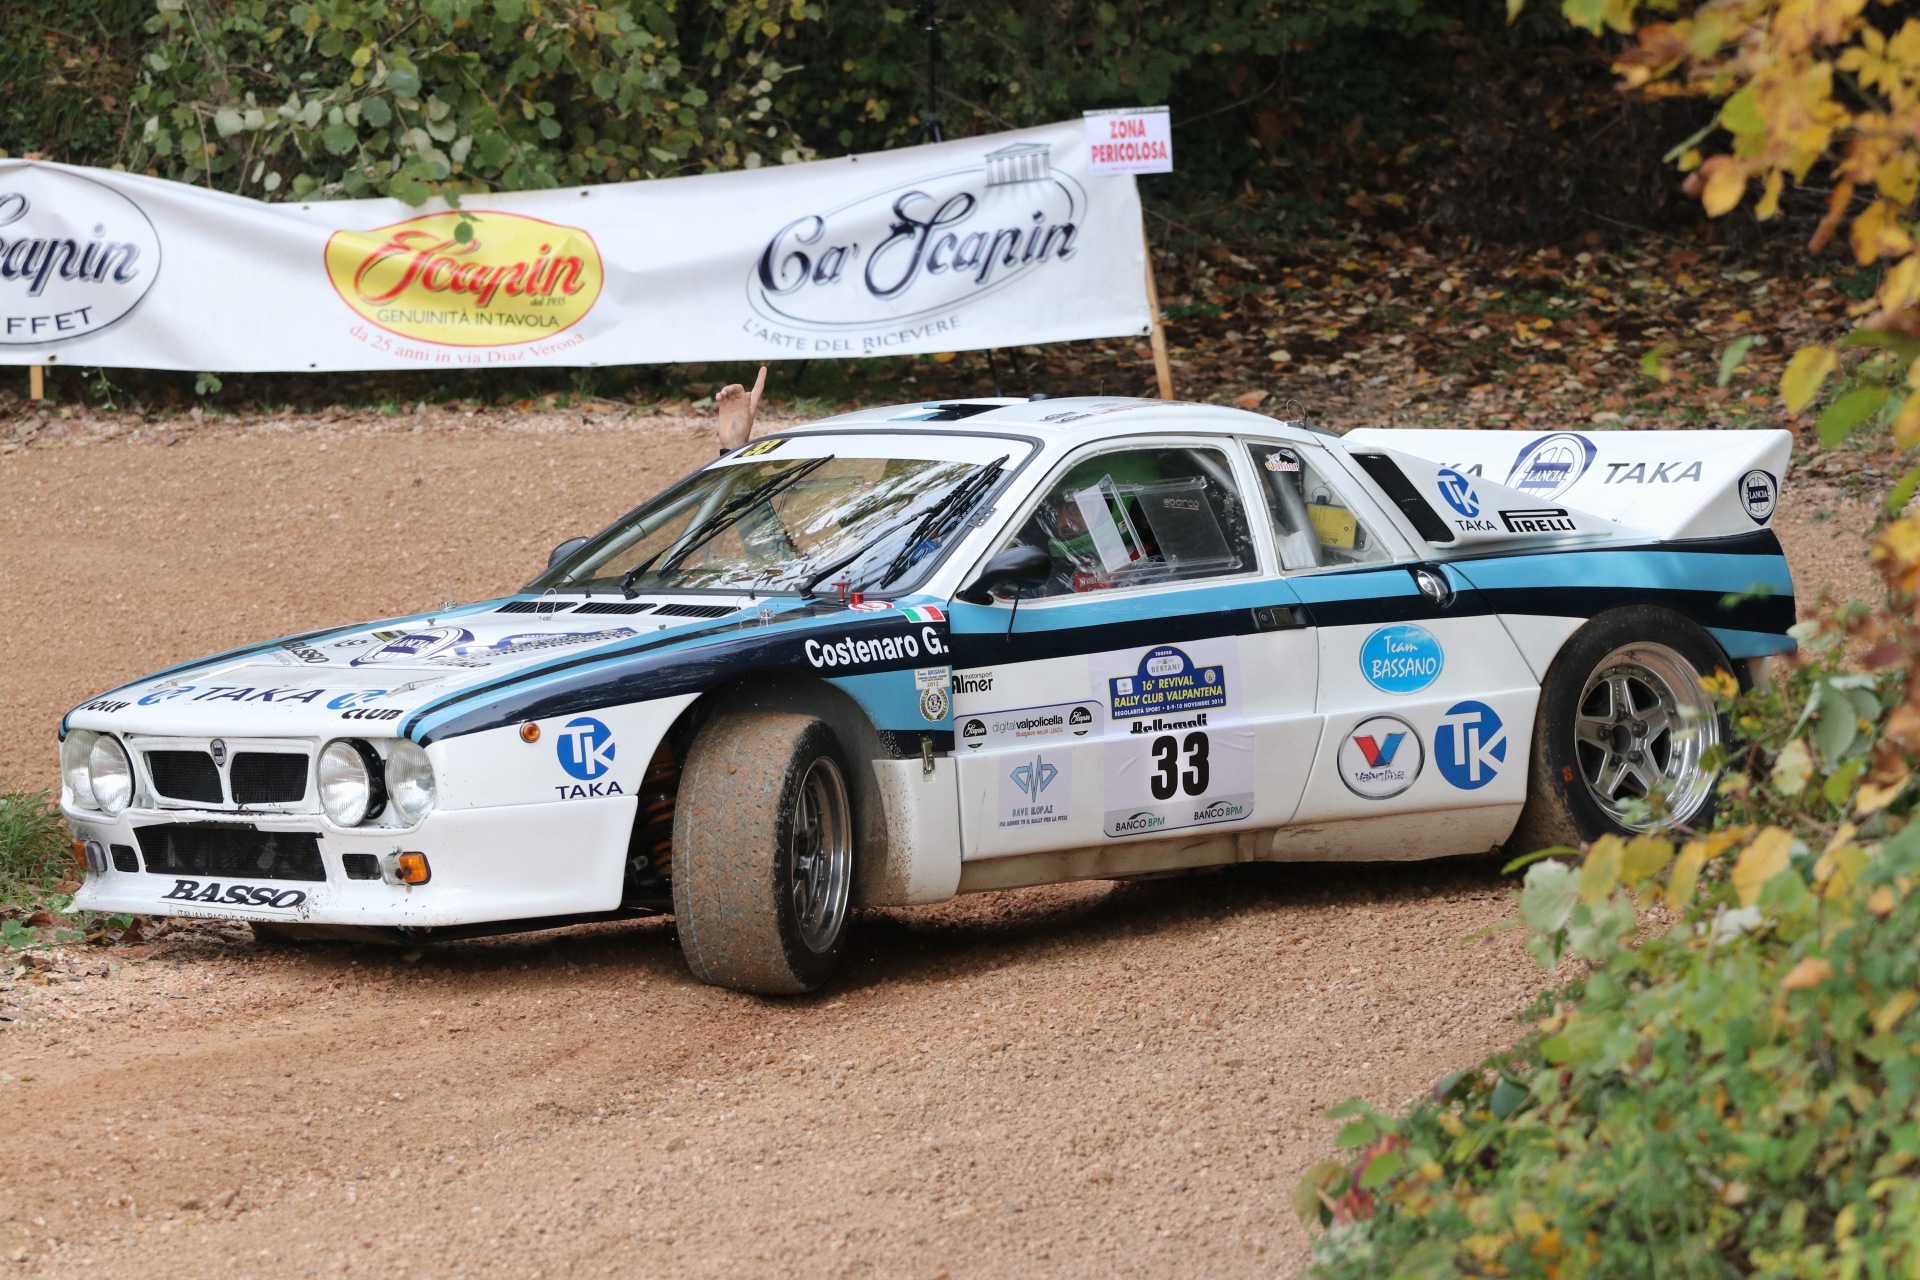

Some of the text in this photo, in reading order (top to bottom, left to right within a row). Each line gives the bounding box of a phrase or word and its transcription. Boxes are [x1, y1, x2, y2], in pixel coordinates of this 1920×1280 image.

[1110, 119, 1146, 139] ZONA
[1091, 141, 1168, 164] PERICOLOSA
[0, 192, 141, 297] apin
[864, 190, 1078, 301] Scapin
[354, 230, 585, 307] Scapin
[547, 296, 567, 307] 1935
[0, 306, 92, 334] FFET
[377, 307, 560, 328] GENUINITÀ IN TAVOLA
[743, 314, 961, 352] L'ARTE DEL RICEVERE
[349, 324, 586, 364] da 25 anni in via Diaz Verona
[1525, 469, 1563, 482] LANCIA
[1603, 461, 1703, 484] TAKA
[1455, 520, 1498, 531] TAKA
[1498, 508, 1577, 533] PIRELLI
[805, 626, 949, 668] Costenaro G.
[1384, 636, 1418, 653] Team
[964, 672, 993, 680] motorsport
[1151, 663, 1180, 673] BERTANI
[1372, 657, 1437, 679] BASSANO
[1159, 675, 1194, 689] REVIVAL
[192, 687, 327, 704] TAKA
[1114, 686, 1223, 708] RALLY CLUB VALPANTENA
[341, 708, 404, 720] CLUB
[1114, 707, 1144, 717] REGOLARITÀ
[1145, 705, 1161, 713] SPORT
[1184, 700, 1210, 709] NOVEMBRE
[992, 715, 1063, 734] digitalvalpolicella
[557, 720, 616, 778] TK
[1436, 706, 1506, 787] TK
[1151, 731, 1209, 800] 33
[555, 781, 624, 800] TAKA
[1194, 805, 1242, 820] BANCO BPM
[1116, 816, 1165, 831] BANCO BPM
[161, 879, 307, 908] BASSO
